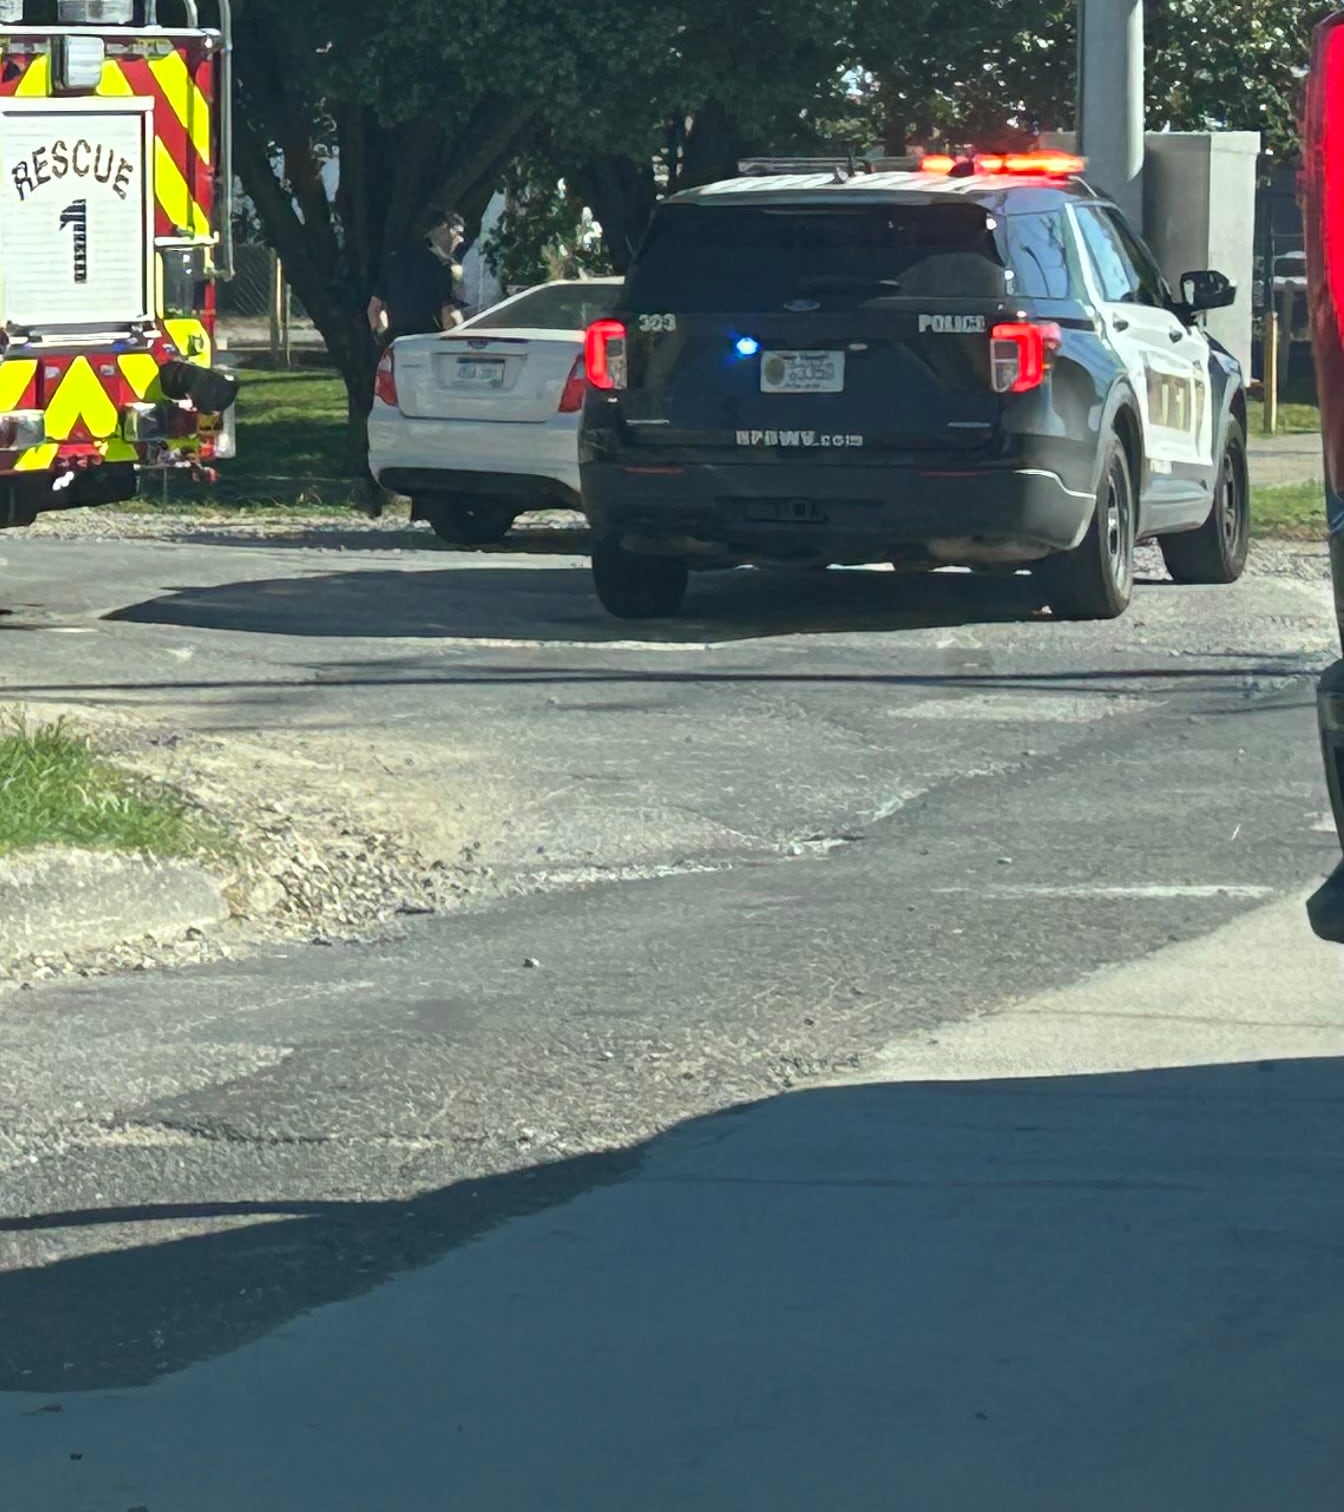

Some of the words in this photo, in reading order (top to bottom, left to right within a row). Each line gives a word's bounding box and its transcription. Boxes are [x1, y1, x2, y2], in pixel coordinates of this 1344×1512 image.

[11, 138, 134, 201] RESCUE
[59, 198, 87, 284] 1
[918, 314, 986, 333] POLICE
